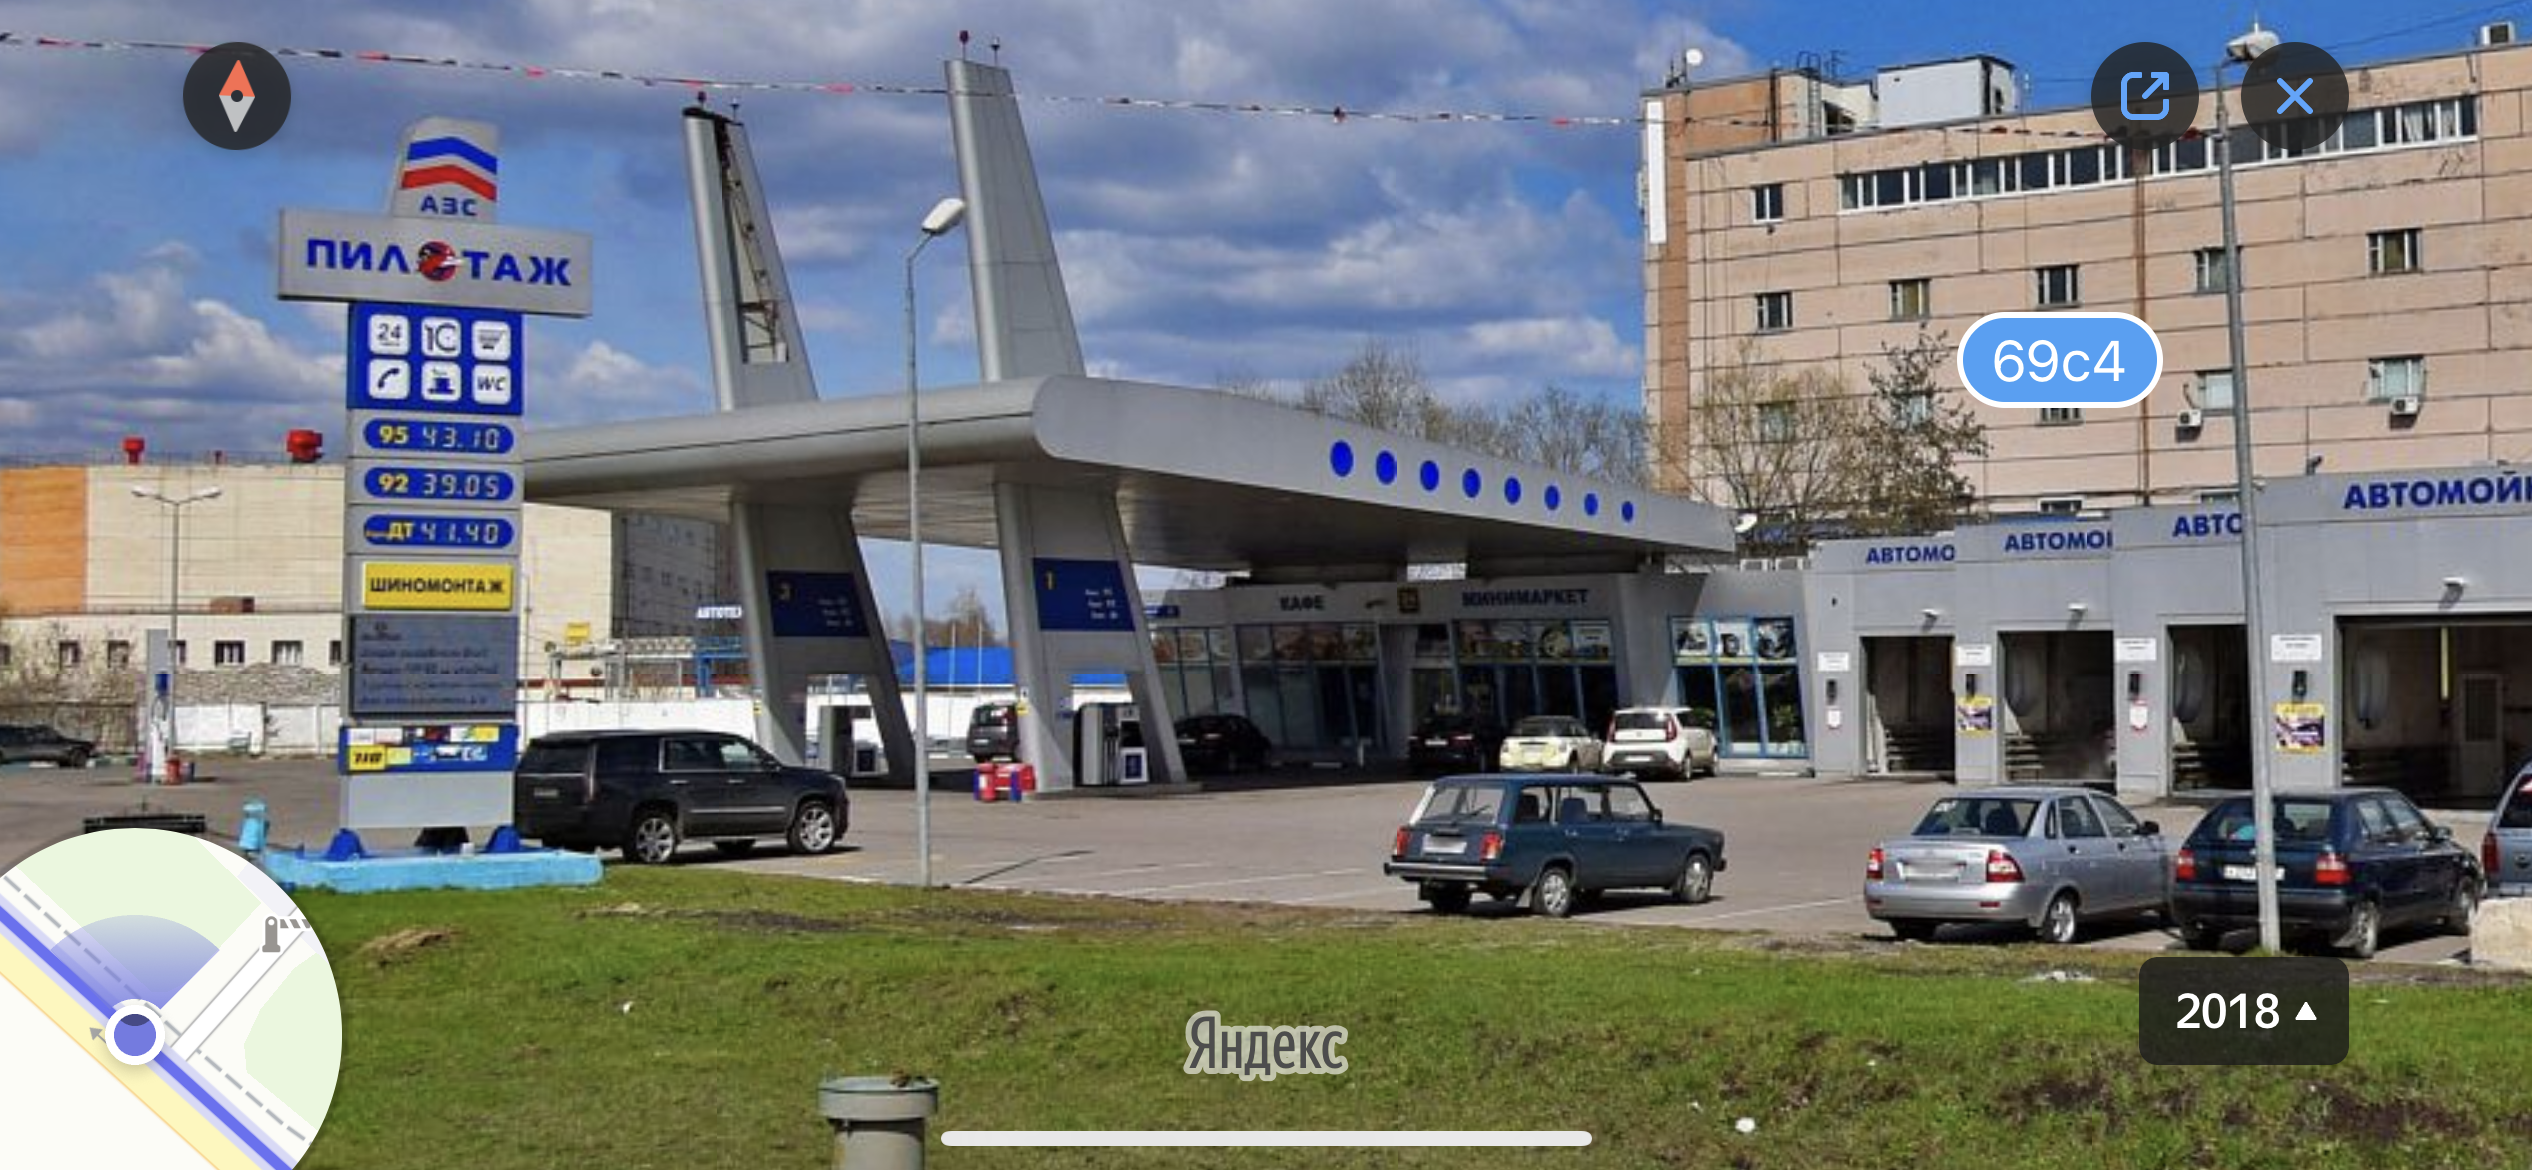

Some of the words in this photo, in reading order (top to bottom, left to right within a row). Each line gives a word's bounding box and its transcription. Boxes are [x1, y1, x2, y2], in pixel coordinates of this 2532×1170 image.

[420, 196, 477, 217] АЗС
[377, 323, 402, 341] 24
[477, 375, 507, 391] WC
[379, 425, 409, 444] 95
[422, 425, 500, 450] 43.10
[379, 473, 409, 493] 92
[423, 472, 500, 497] 39.05
[420, 522, 500, 545] 41.40
[2005, 529, 2113, 552] АВТОМО
[1865, 543, 1956, 564] АВТОМО
[370, 577, 505, 595] ШИНОМОНТАЖ
[1279, 594, 1325, 612] КАФЕ
[1461, 588, 1588, 607] МИНИМАРКЕТ
